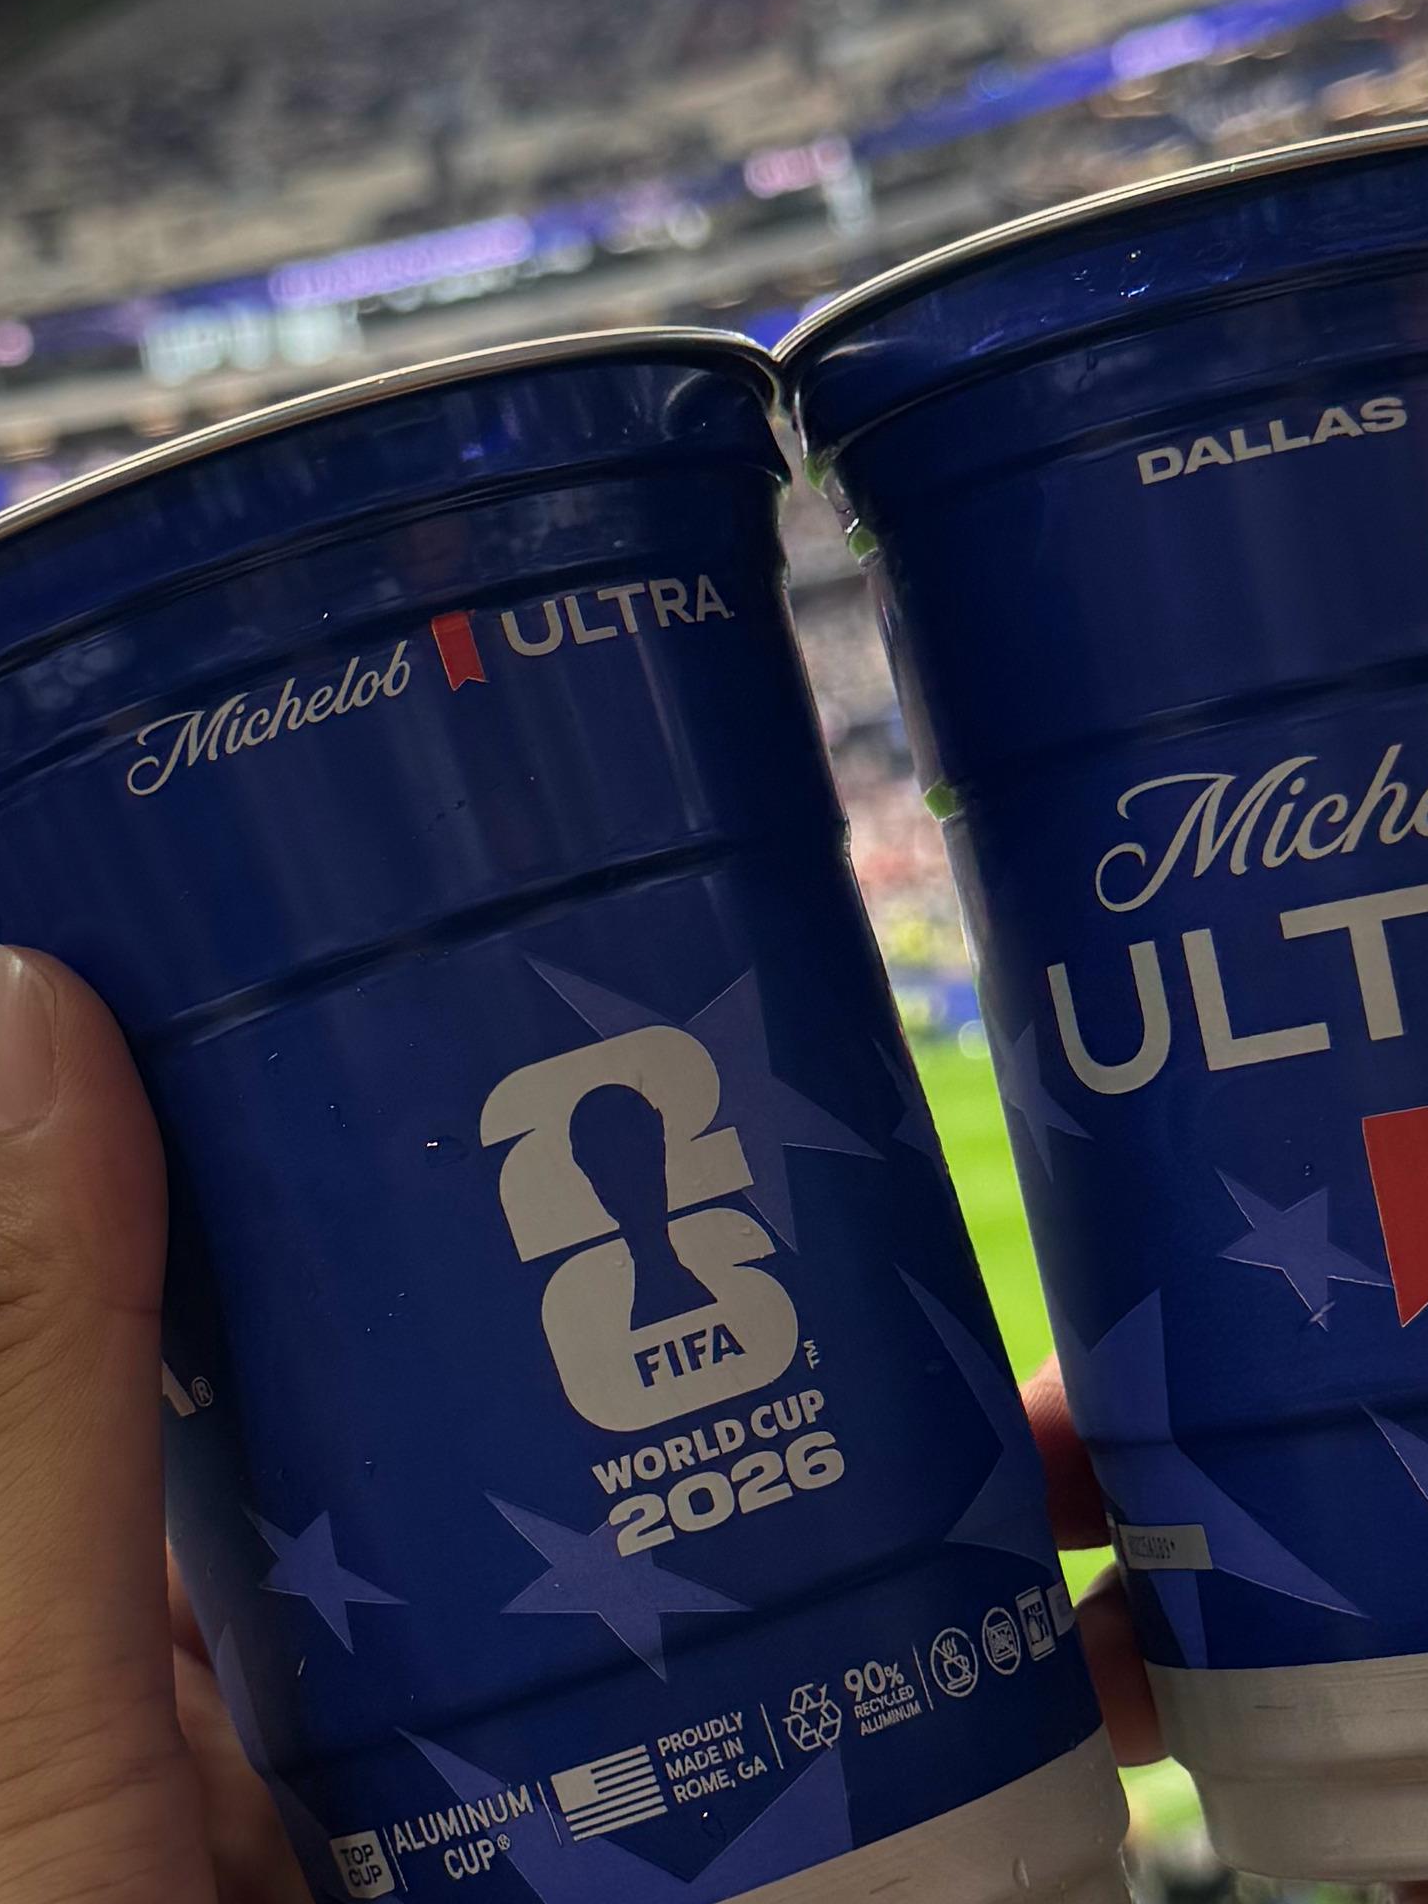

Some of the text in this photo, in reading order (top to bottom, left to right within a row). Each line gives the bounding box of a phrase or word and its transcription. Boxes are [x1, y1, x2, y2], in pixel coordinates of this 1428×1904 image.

[1136, 395, 1407, 486] DALLAS
[127, 574, 734, 796] Michelob ULTRA
[634, 1323, 746, 1387] FIFA
[592, 1389, 824, 1494] WORLD CUP
[608, 1431, 844, 1557] 2026
[844, 1660, 904, 1702] 90%
[854, 1684, 915, 1719] RECYCLED
[657, 1711, 743, 1756] PROUDLY
[860, 1699, 922, 1737] ALUMINUM
[665, 1736, 744, 1780] MADE IN
[673, 1755, 768, 1803] ROME, GA
[393, 1784, 534, 1854] ALUMINUM
[340, 1844, 375, 1867] TOP
[348, 1864, 383, 1888] CUP
